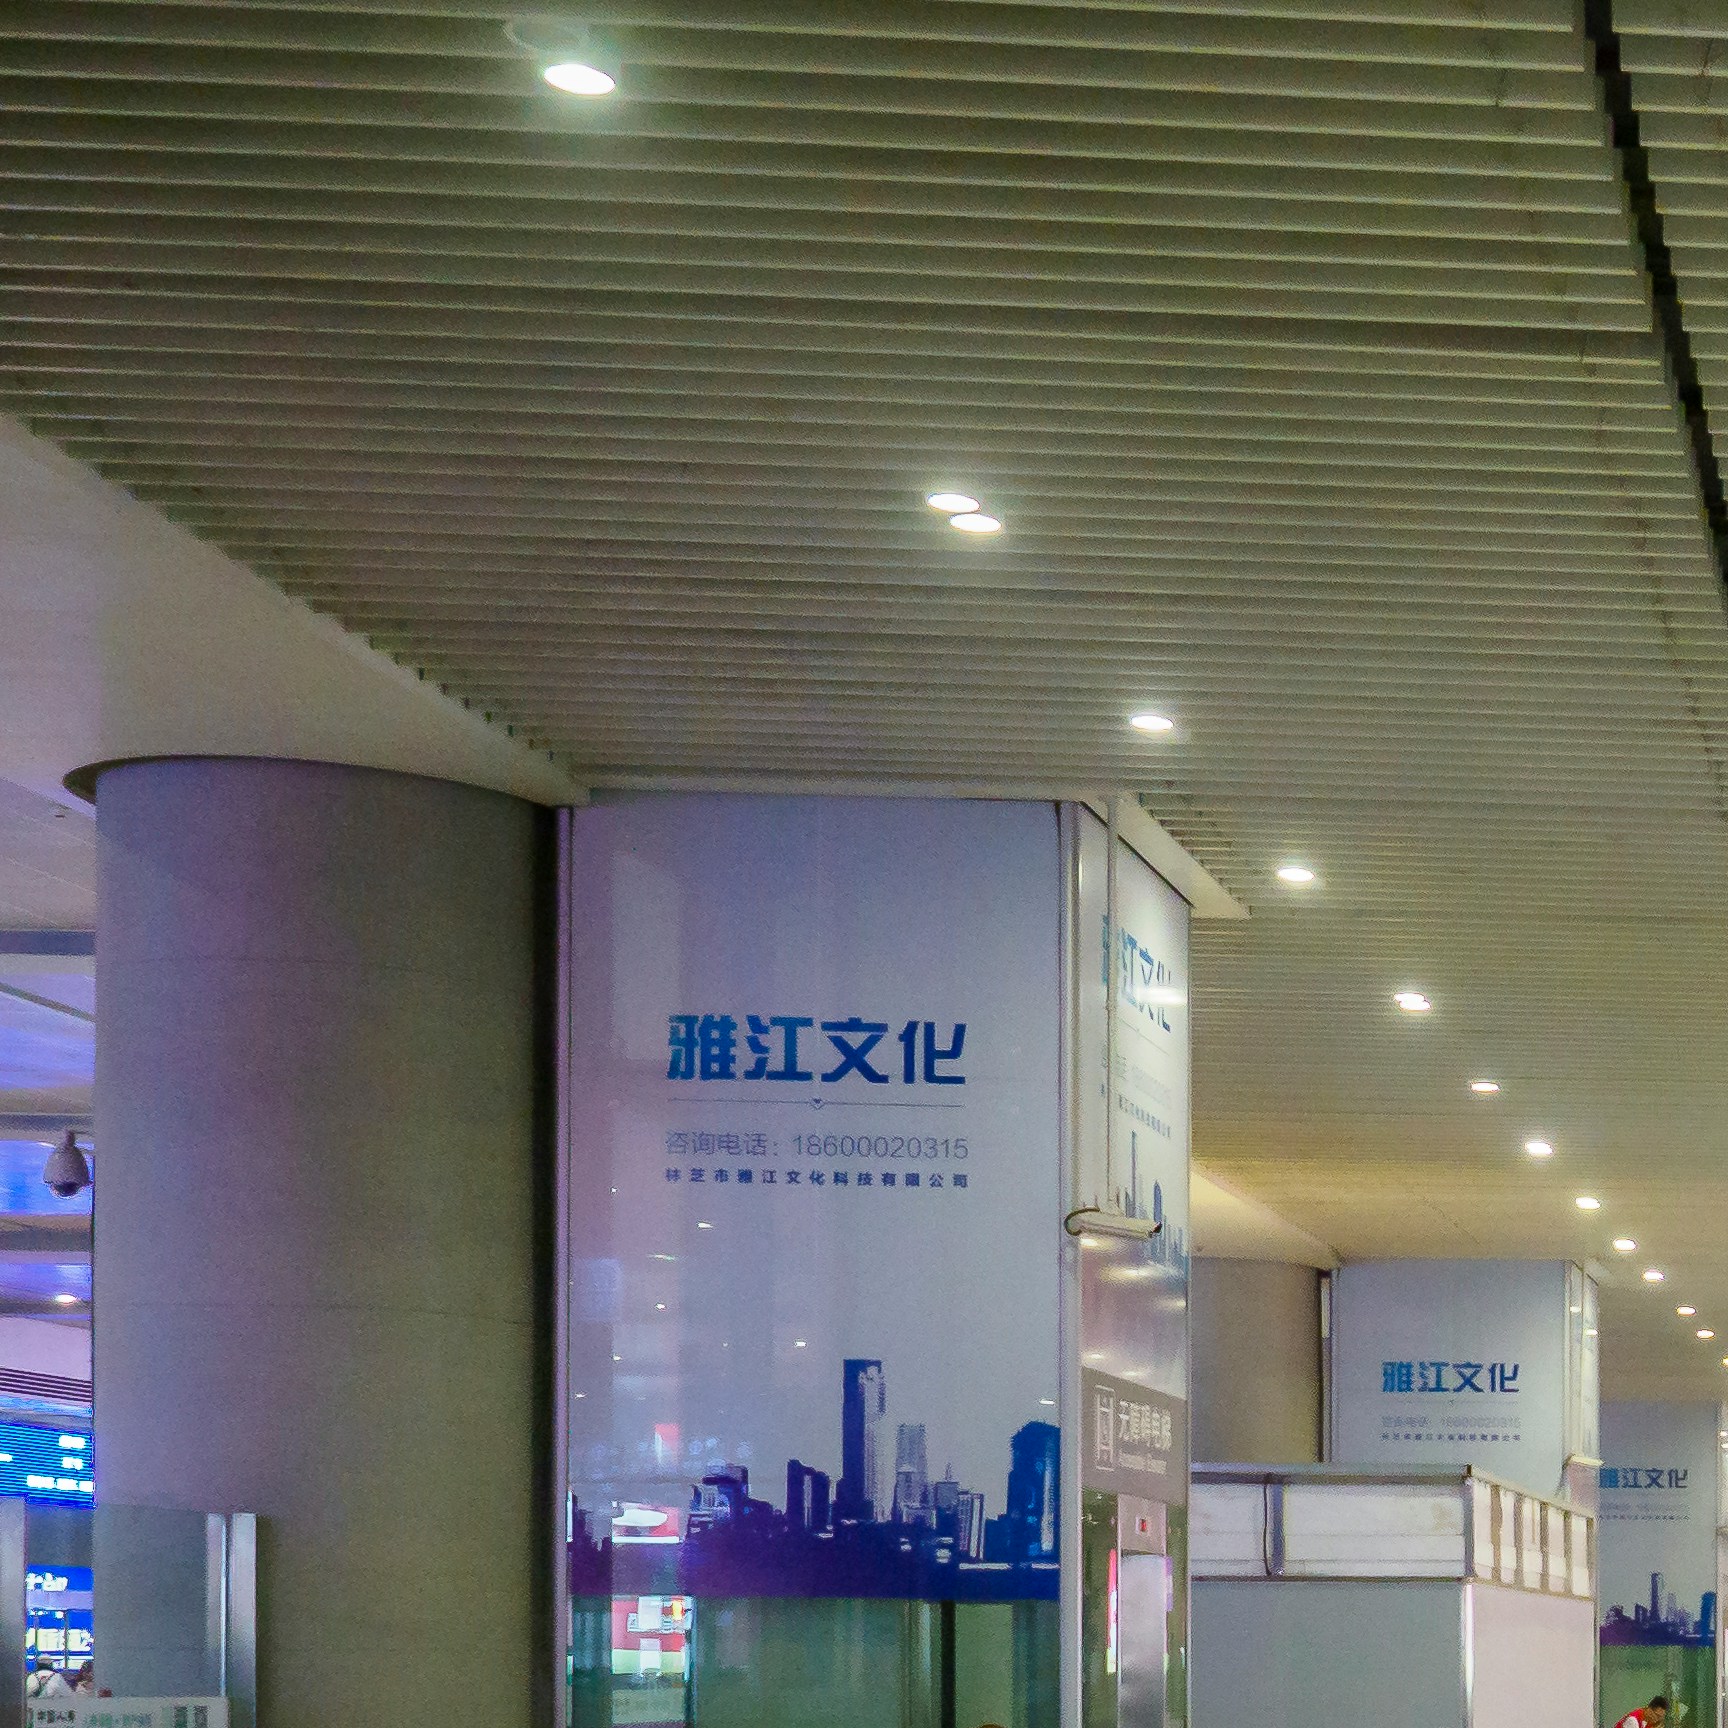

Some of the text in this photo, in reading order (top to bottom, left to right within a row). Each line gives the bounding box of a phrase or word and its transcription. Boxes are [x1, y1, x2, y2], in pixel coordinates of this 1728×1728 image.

[667, 1015, 967, 1085] 雅江文化
[793, 1134, 969, 1160] 18600020315
[1382, 1361, 1520, 1393] 雅江文化
